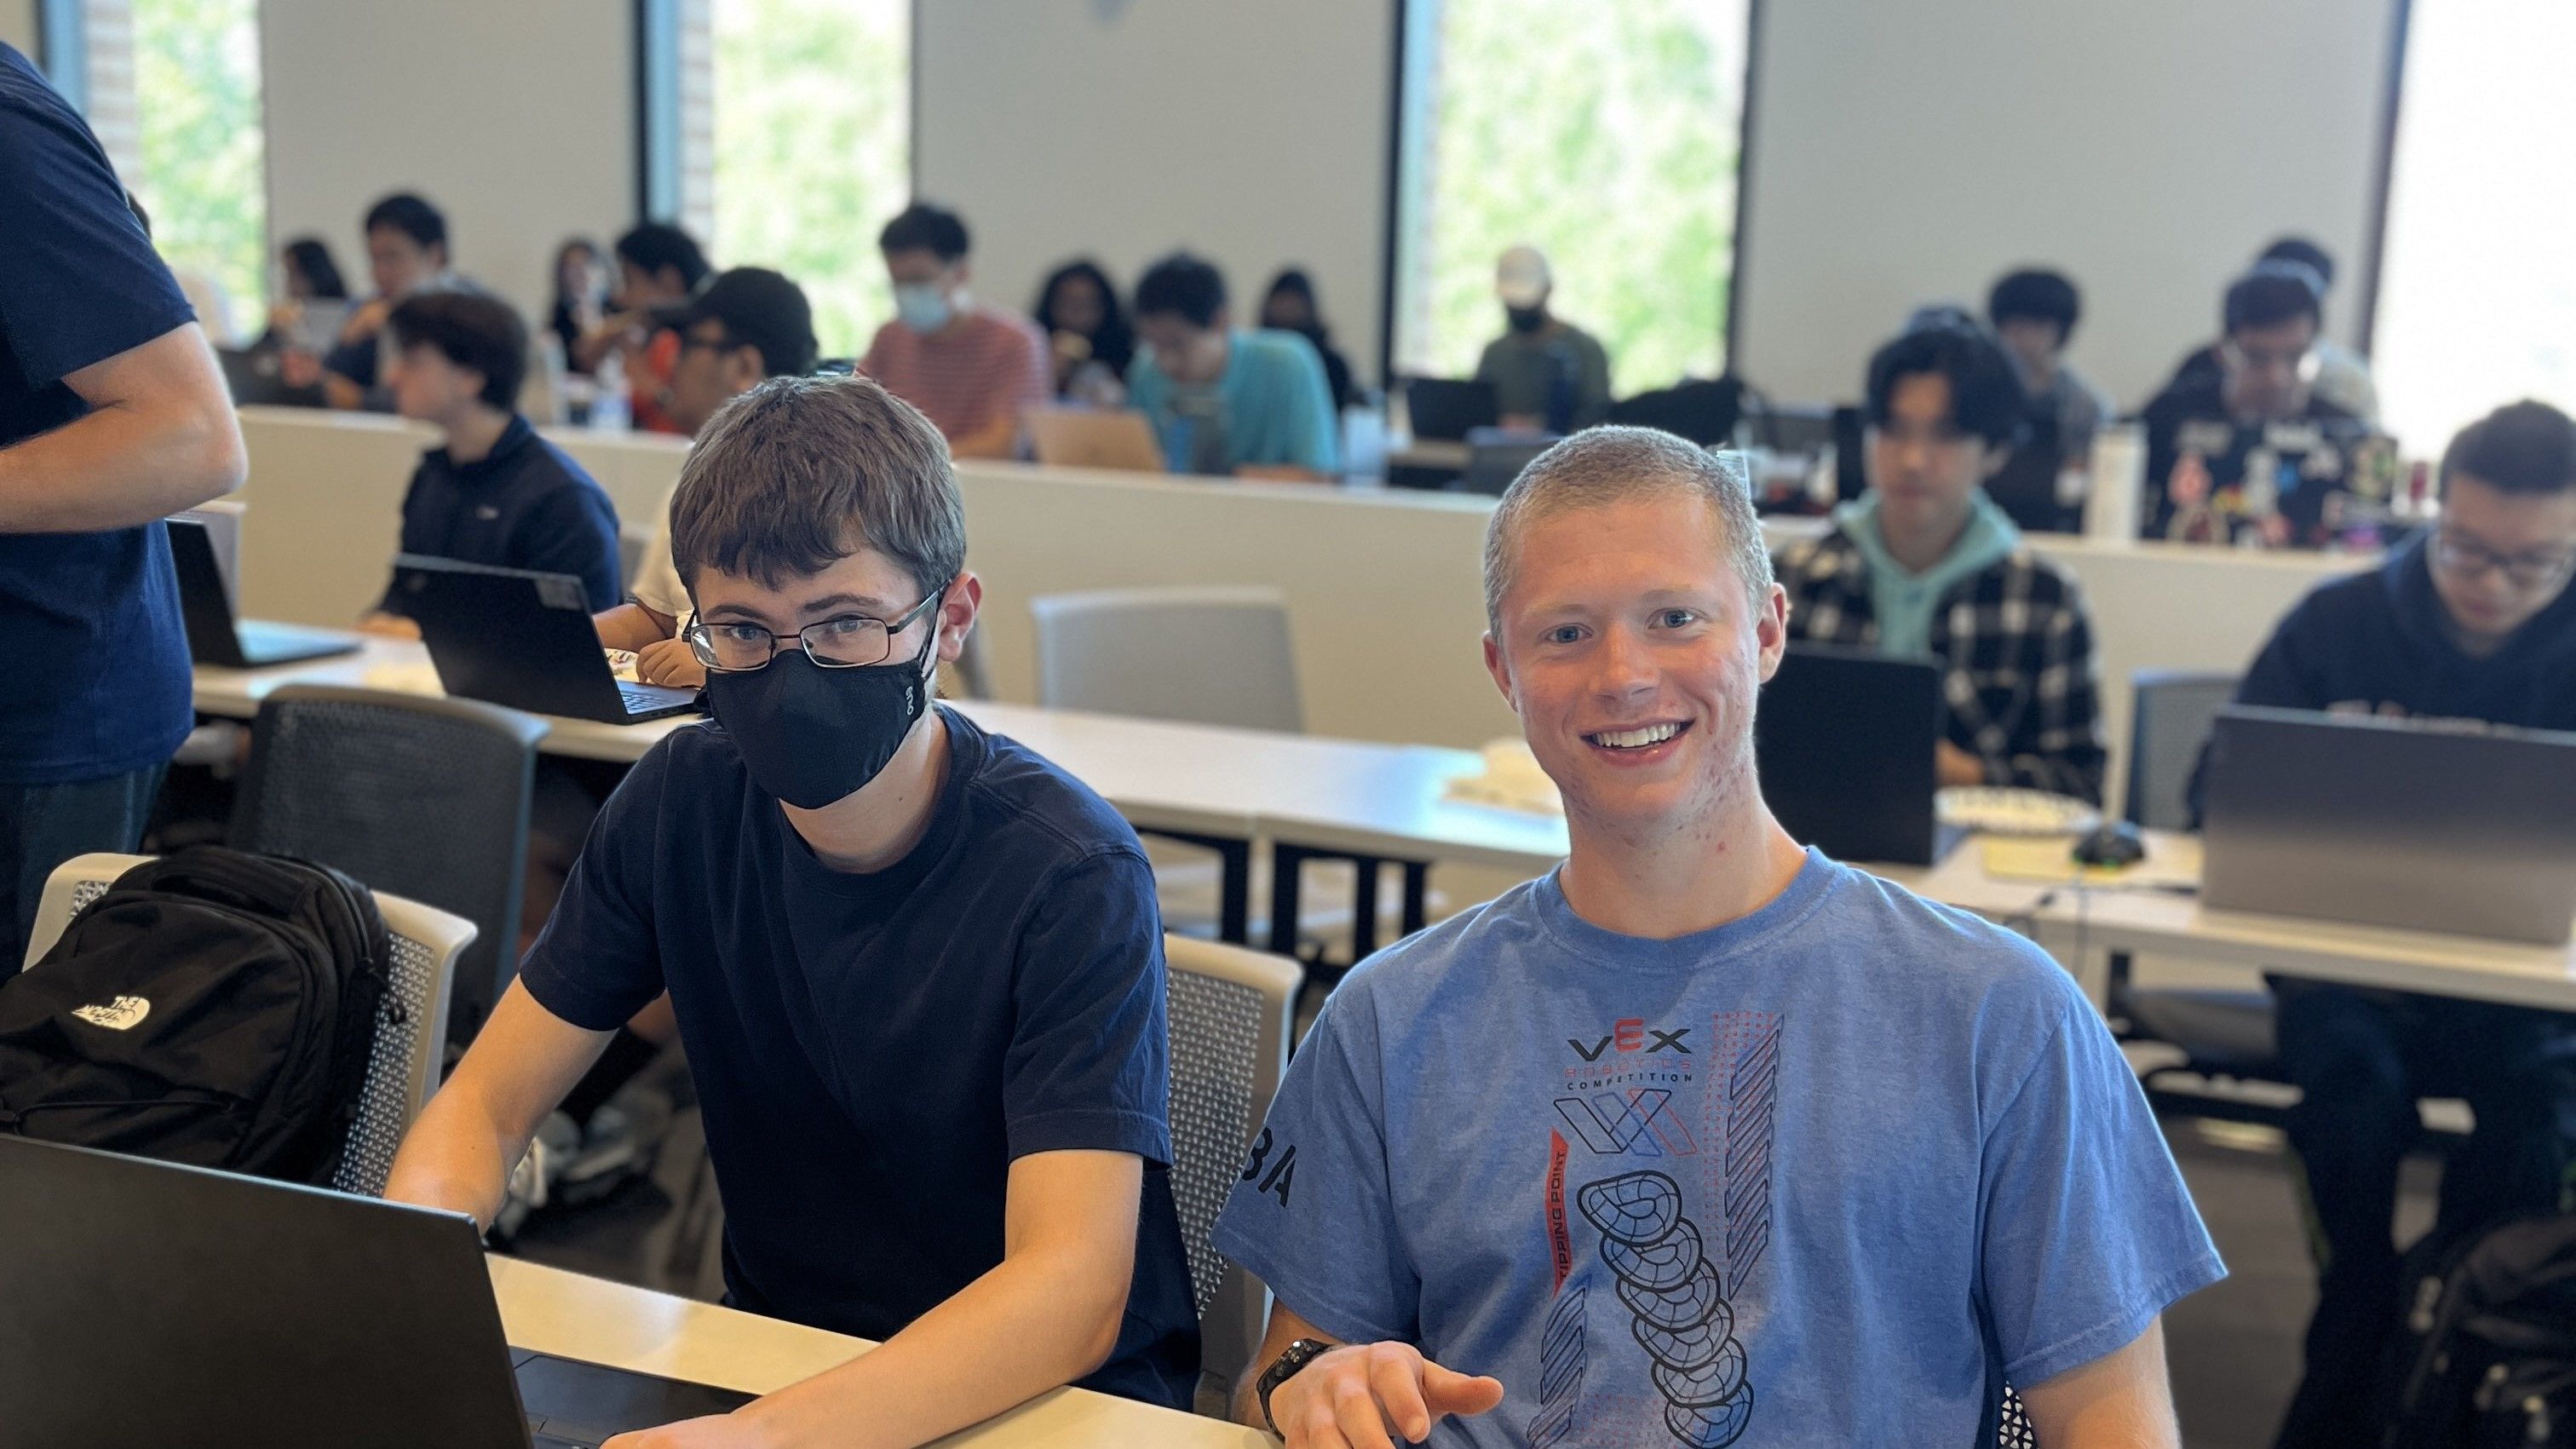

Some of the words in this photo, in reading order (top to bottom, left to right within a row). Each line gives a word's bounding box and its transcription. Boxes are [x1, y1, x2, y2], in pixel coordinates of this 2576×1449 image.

[1567, 1017, 1692, 1061] VEX
[1567, 1072, 1693, 1090] COMPETITION
[1550, 1152, 1567, 1203] POINT
[1551, 1207, 1569, 1282] TIPPING
